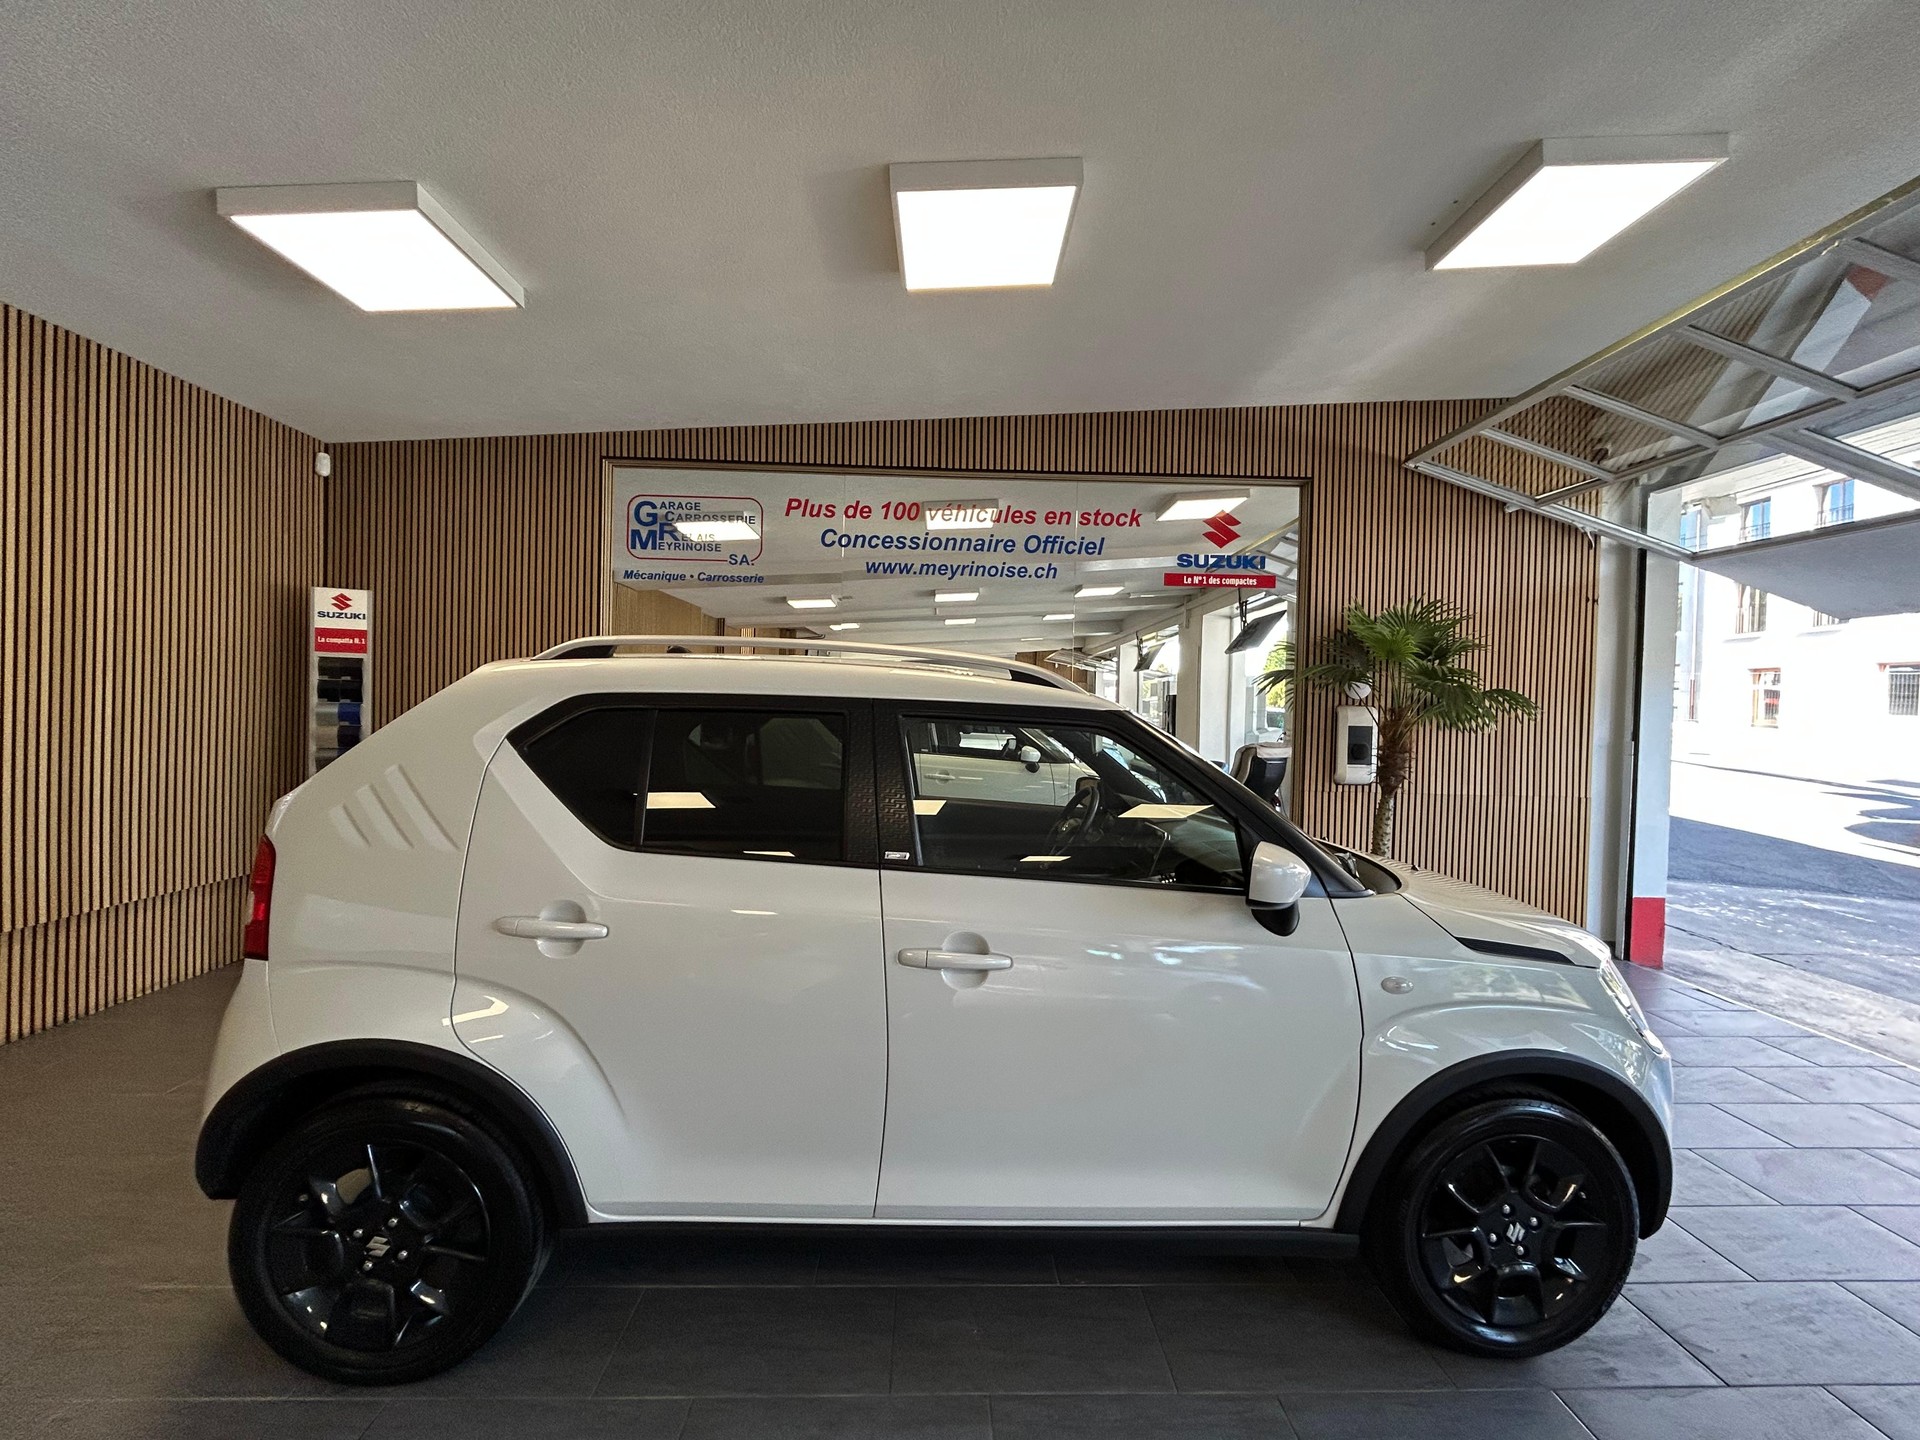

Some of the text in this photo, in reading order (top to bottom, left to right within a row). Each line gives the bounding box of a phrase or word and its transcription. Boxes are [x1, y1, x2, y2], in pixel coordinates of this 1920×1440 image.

[664, 510, 756, 525] CARROSSERIE
[784, 498, 1142, 528] Plus de 100 véhicules en stock
[630, 529, 722, 552] MEYRINOISE
[820, 529, 1106, 556] Concessionnaire Officiel
[865, 559, 1059, 580] www.meyrinoise.ch
[1176, 553, 1266, 570] SUZUKI
[623, 570, 765, 584] Mécanique Carrosserie
[1183, 575, 1192, 584] Le
[1208, 576, 1221, 585] des
[1221, 577, 1257, 587] compactes
[317, 611, 366, 620] SUZUKI
